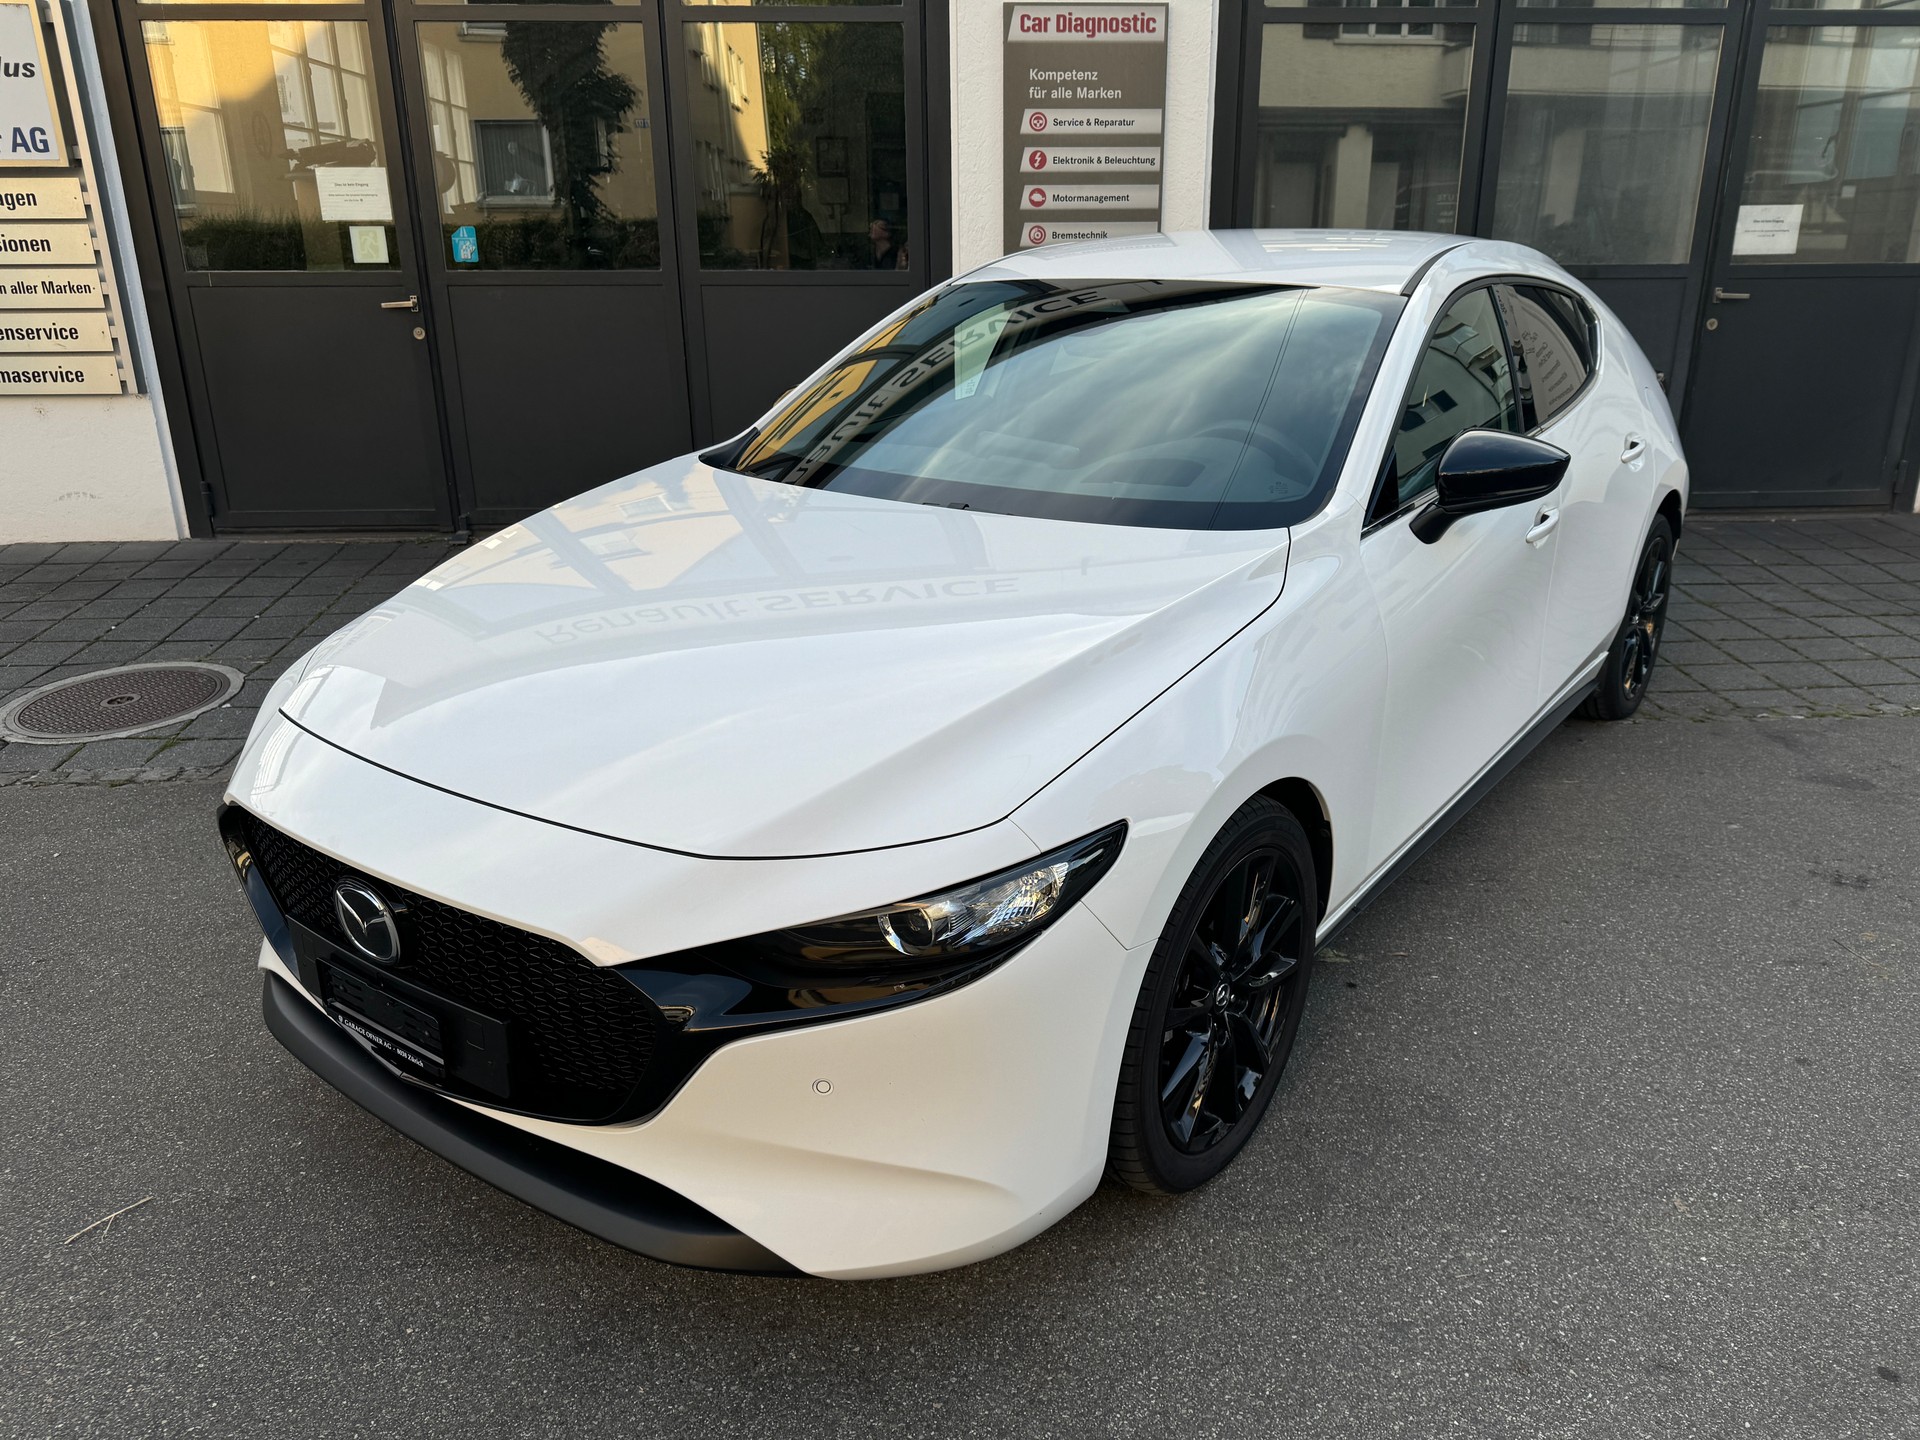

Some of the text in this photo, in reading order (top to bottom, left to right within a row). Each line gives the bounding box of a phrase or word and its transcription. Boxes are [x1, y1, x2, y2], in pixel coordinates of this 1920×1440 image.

[1019, 12, 1157, 38] Car Diagnostic
[0, 56, 36, 78] us
[1029, 68, 1098, 83] Kompetenz
[1029, 86, 1122, 99] für alle Marken
[1052, 118, 1135, 128] Service & Reparatur
[12, 126, 50, 154] AG
[1052, 156, 1156, 167] Elektronik & Beleuchtung
[1052, 194, 1130, 204] Motormanagement
[1051, 230, 1108, 239] Bremstechnik
[0, 234, 52, 253] ionen
[10, 281, 39, 295] aller
[41, 281, 92, 295] Marken
[344, 1019, 366, 1036] GARAGE
[383, 1042, 392, 1050] AG
